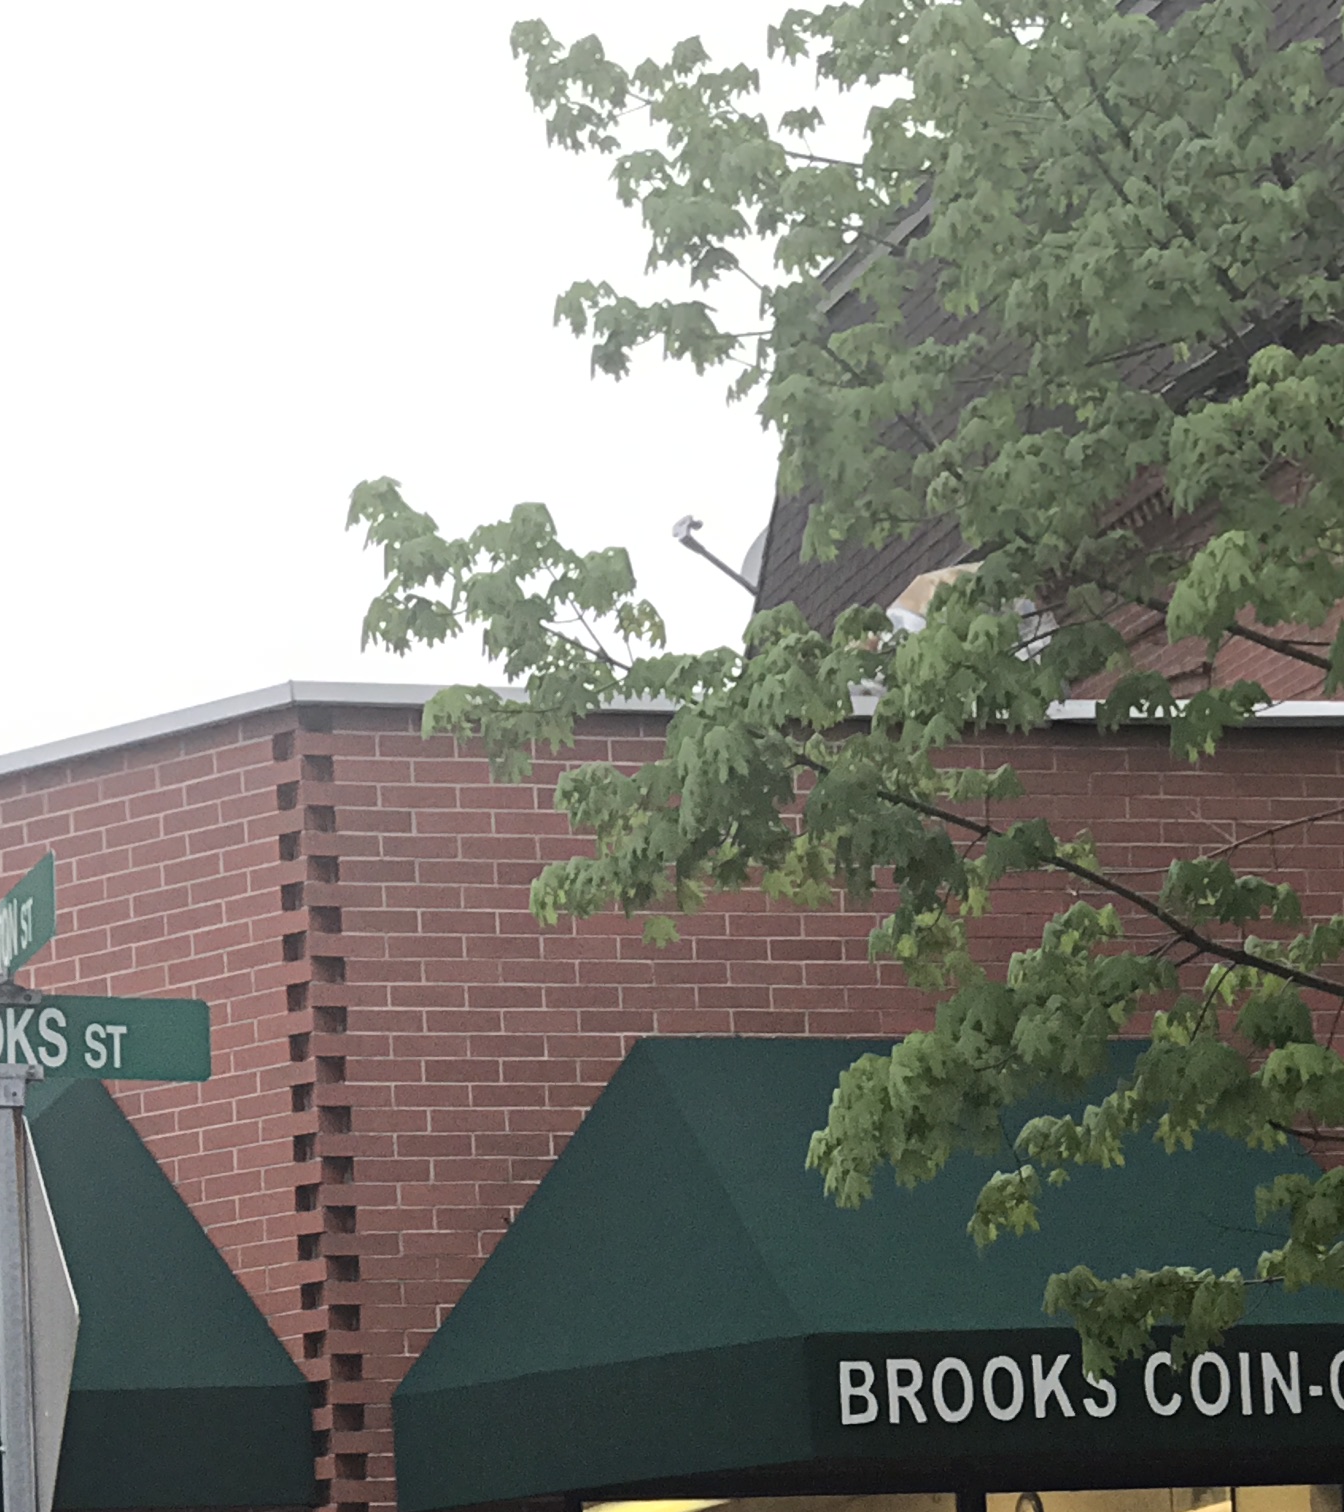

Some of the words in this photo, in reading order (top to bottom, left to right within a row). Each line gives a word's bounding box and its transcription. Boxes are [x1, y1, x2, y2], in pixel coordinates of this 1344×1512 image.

[21, 896, 34, 949] ST
[84, 1023, 128, 1069] ST
[839, 1347, 1117, 1425] BROOKS
